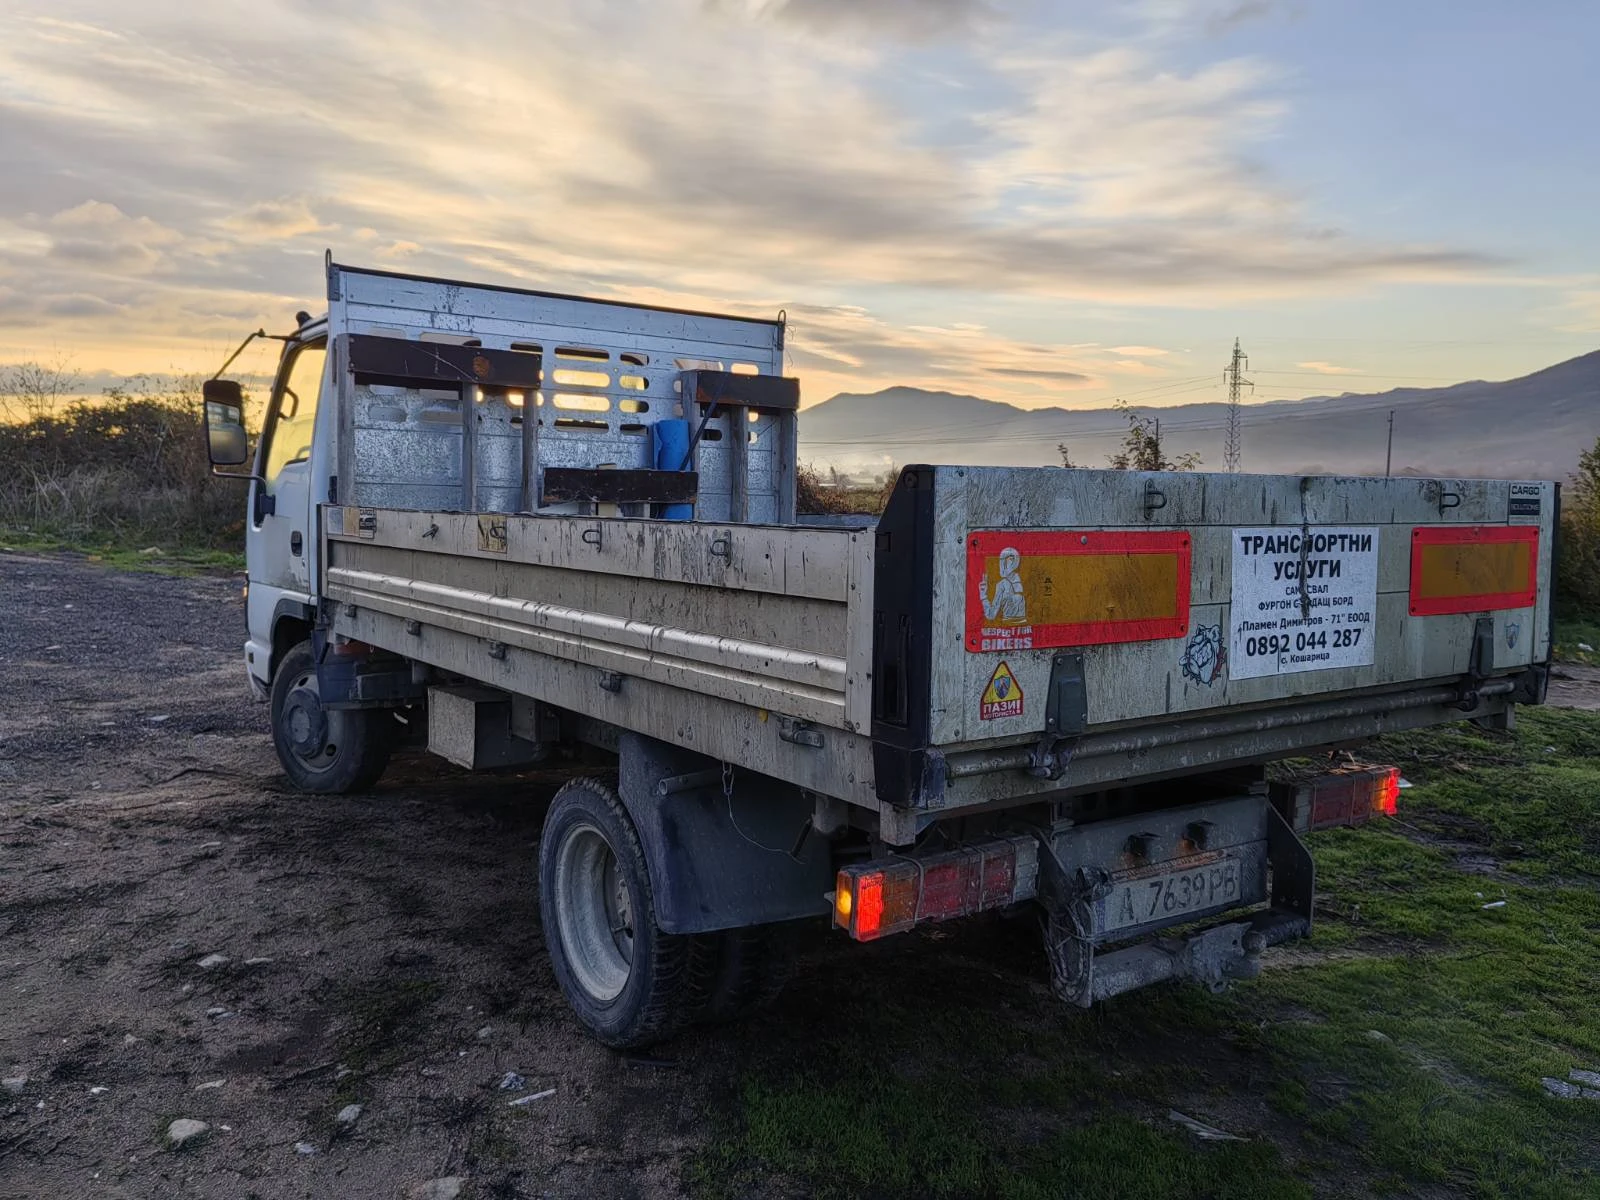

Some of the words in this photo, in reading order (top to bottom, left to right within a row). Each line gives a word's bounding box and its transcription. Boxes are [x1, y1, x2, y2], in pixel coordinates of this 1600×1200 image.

[1511, 485, 1540, 496] CARGO
[1285, 584, 1329, 596] САМСВАЛ
[1258, 599, 1291, 611] ФУРГОН
[1332, 596, 1353, 606] БОРД
[1280, 616, 1323, 629] Димитров
[1347, 612, 1370, 623] ЕООД
[982, 638, 1032, 650] BIKERS
[1246, 634, 1290, 656] 0892
[1296, 630, 1327, 651] 044
[1332, 628, 1361, 648] 287
[1290, 652, 1330, 663] Кошарица
[984, 700, 1021, 714] ПАЗИ!
